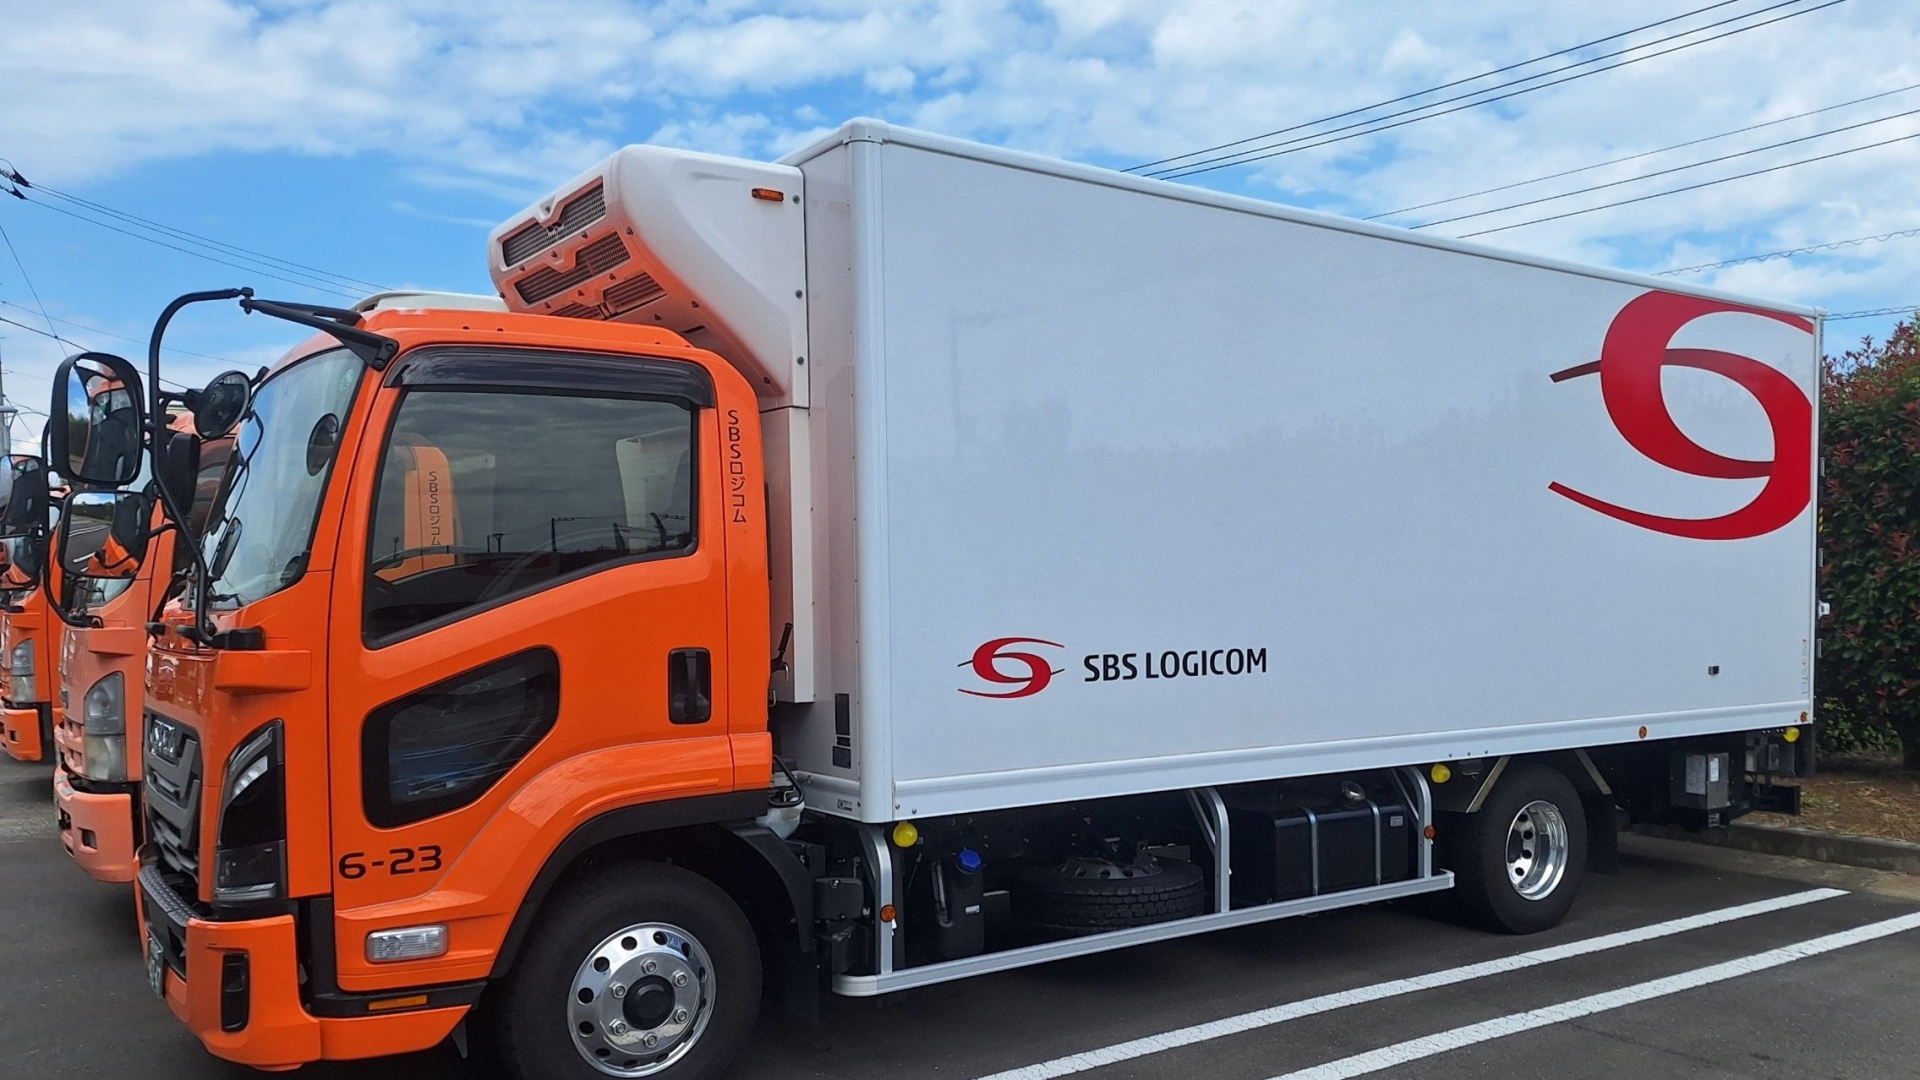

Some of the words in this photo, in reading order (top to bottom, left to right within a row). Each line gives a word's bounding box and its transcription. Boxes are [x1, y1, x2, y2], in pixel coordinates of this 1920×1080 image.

[727, 409, 747, 523] SBSロジコム
[428, 471, 441, 546] SBSロジコム
[1083, 653, 1138, 682] SBS
[1146, 647, 1267, 679] LOGICOM
[338, 844, 442, 880] 6-23
